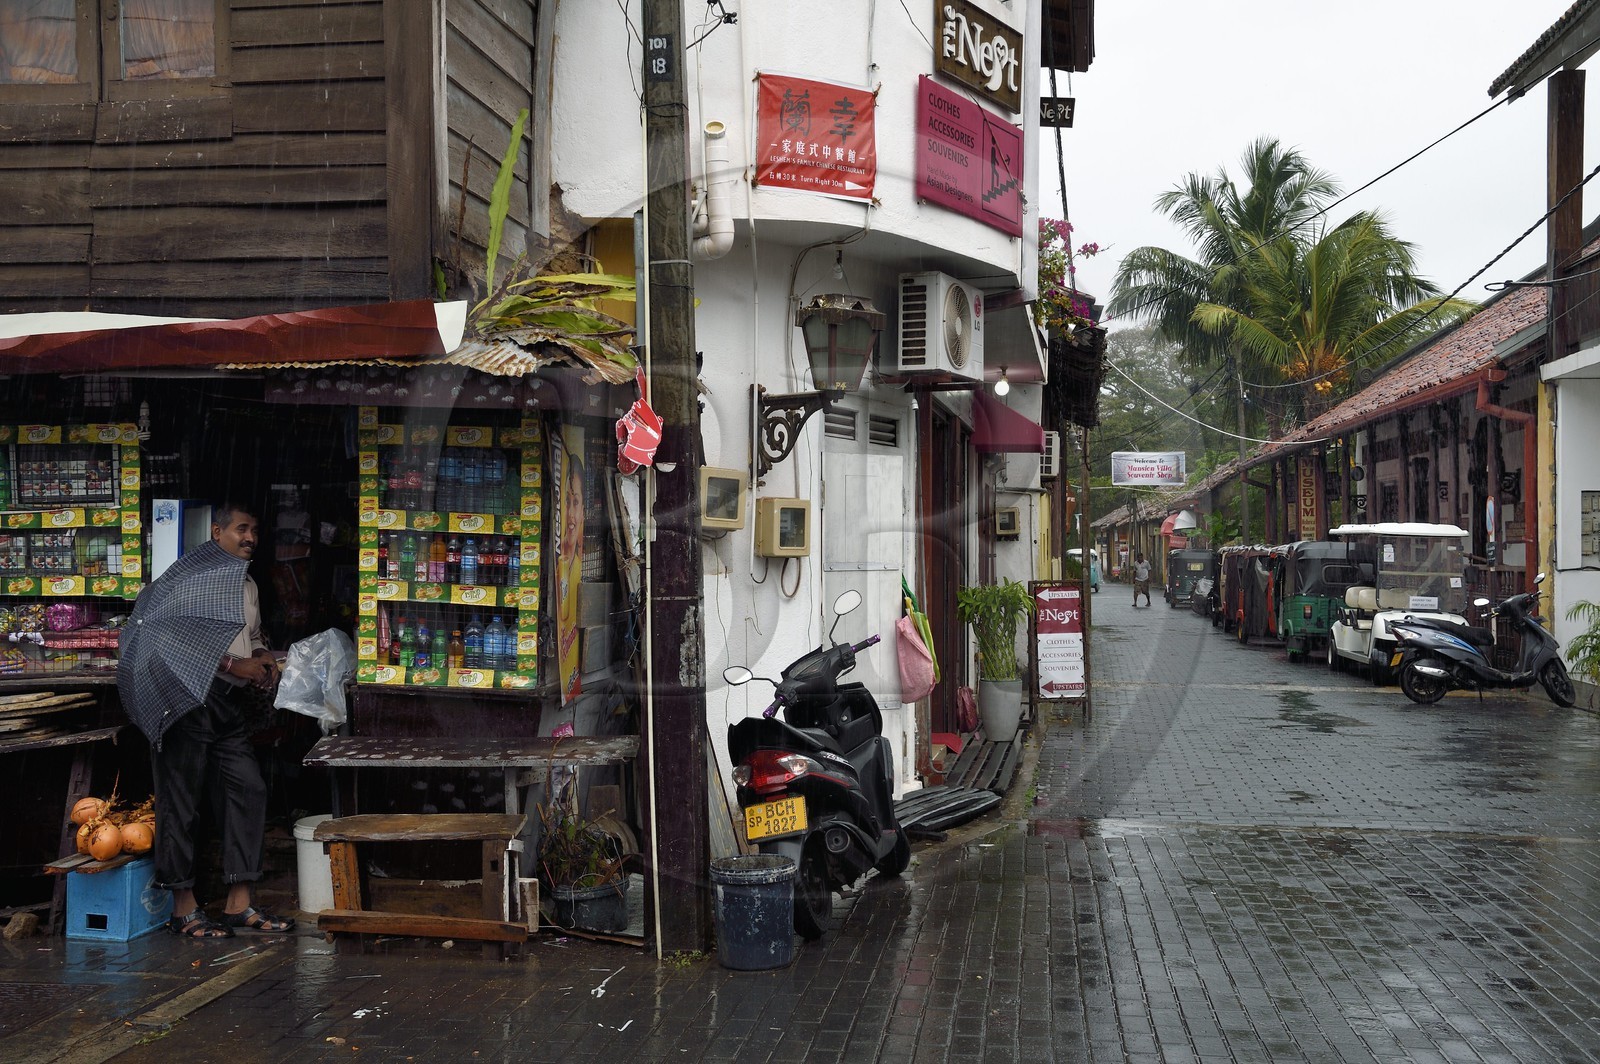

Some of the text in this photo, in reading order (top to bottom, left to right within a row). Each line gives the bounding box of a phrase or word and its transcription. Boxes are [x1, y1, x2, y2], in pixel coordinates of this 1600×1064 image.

[648, 37, 667, 50] 101
[955, 12, 1018, 92] Nest
[652, 57, 667, 74] 18
[928, 92, 961, 119] CLOTHES
[928, 116, 975, 149] ACCESSORIES
[927, 138, 969, 168] SOUVENIRS
[797, 158, 815, 167] FAMILY
[816, 161, 836, 170] CHINESE
[836, 164, 865, 175] RESTAURANT
[800, 175, 813, 183] Turn
[815, 177, 830, 187] Right
[926, 174, 974, 203] Asian Designers
[974, 319, 981, 331] LG
[1302, 459, 1315, 516] MUSEUM
[1045, 608, 1079, 625] Nest
[748, 800, 796, 828] SP BCH
[764, 815, 797, 835] 1827
